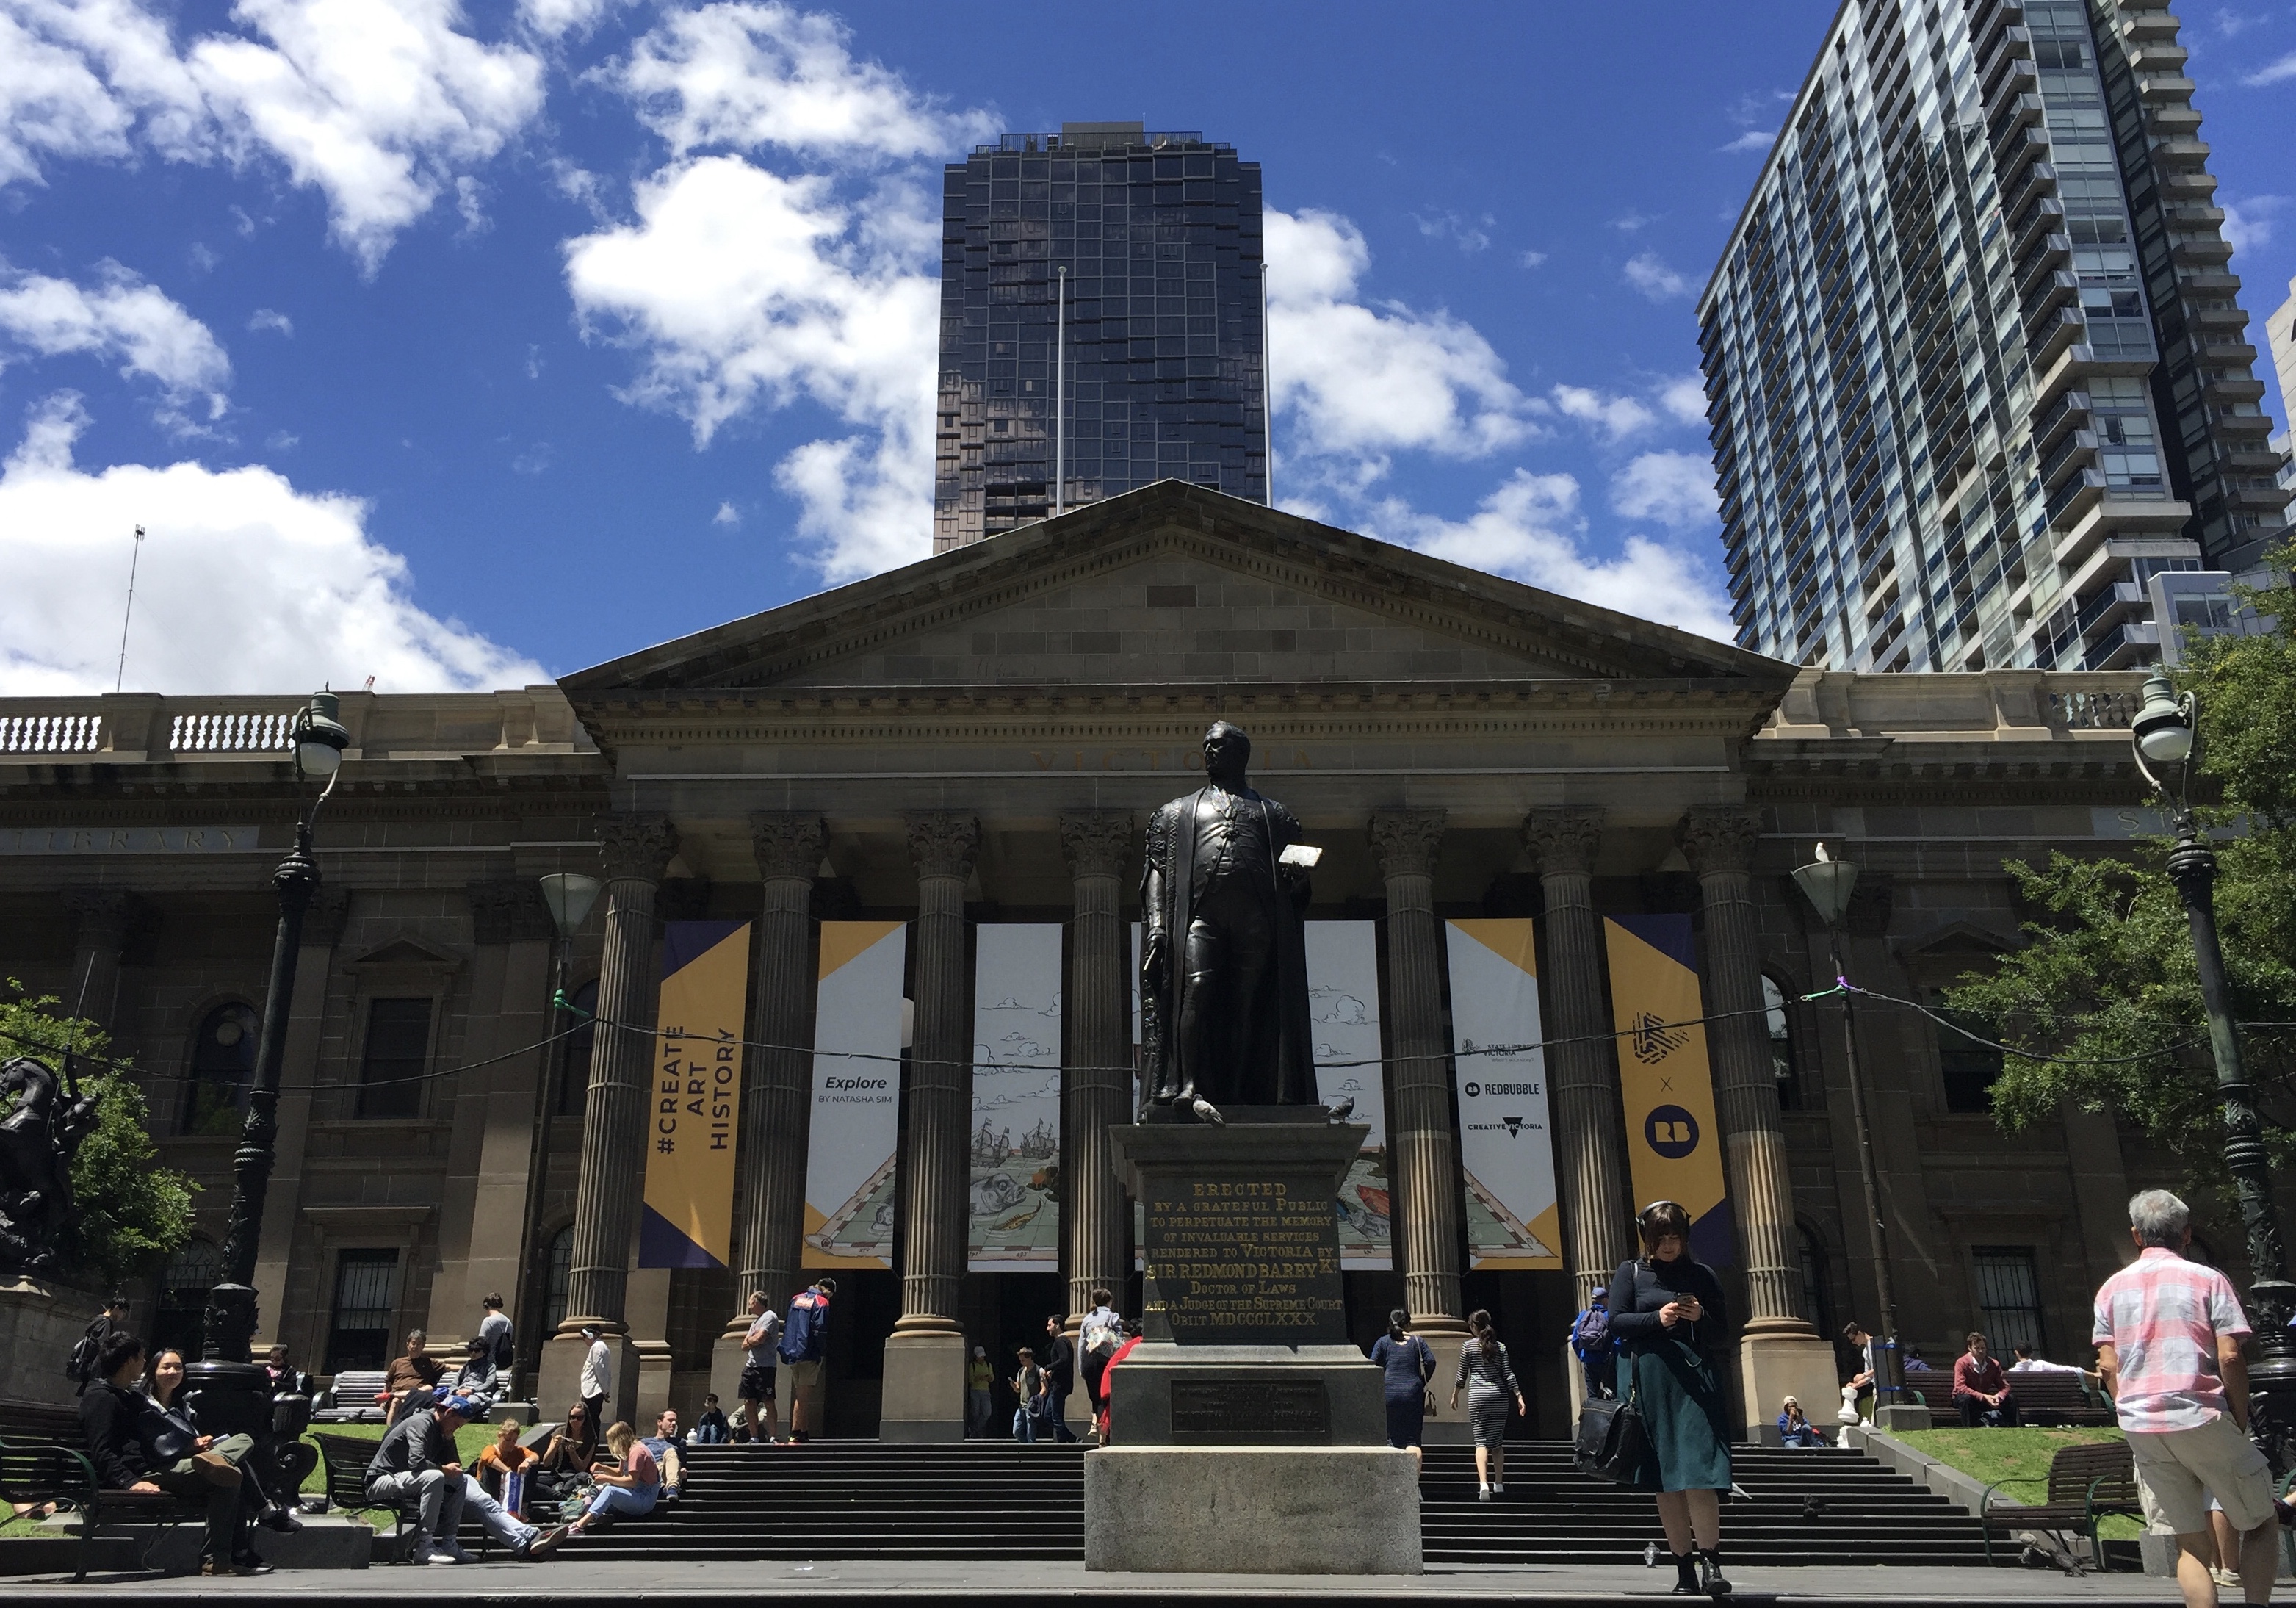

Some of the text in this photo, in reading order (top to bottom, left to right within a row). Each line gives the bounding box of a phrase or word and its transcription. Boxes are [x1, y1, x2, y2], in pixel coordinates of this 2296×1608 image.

[1030, 749, 1313, 771] VICTOIA
[687, 1061, 707, 1117] ART
[710, 1028, 735, 1150] HISTORY
[826, 1077, 887, 1091] Explore
[1485, 1084, 1539, 1095] REDBUBBLE
[657, 1026, 683, 1155] #CREATE
[1194, 1183, 1287, 1196] ERECTED
[1154, 1202, 1172, 1211] BY
[1177, 1203, 1187, 1211] A
[1194, 1202, 1269, 1211] GRATEFUL
[1150, 1216, 1332, 1227] TO PERPETUATE THE MEMORY
[1163, 1232, 1320, 1242] OF INVALUABLE SERVICES
[1152, 1248, 1217, 1258] RENDERED
[1223, 1248, 1238, 1258] TO
[1318, 1247, 1333, 1257] BY
[1145, 1264, 1177, 1280] SIR
[1180, 1263, 1257, 1278] REDMOND
[1259, 1263, 1318, 1278] BARRY
[1241, 1285, 1255, 1294] OF
[1145, 1300, 1169, 1311] AND
[1169, 1301, 1177, 1310] A
[1217, 1300, 1228, 1310] OF
[1230, 1300, 1252, 1310] THE
